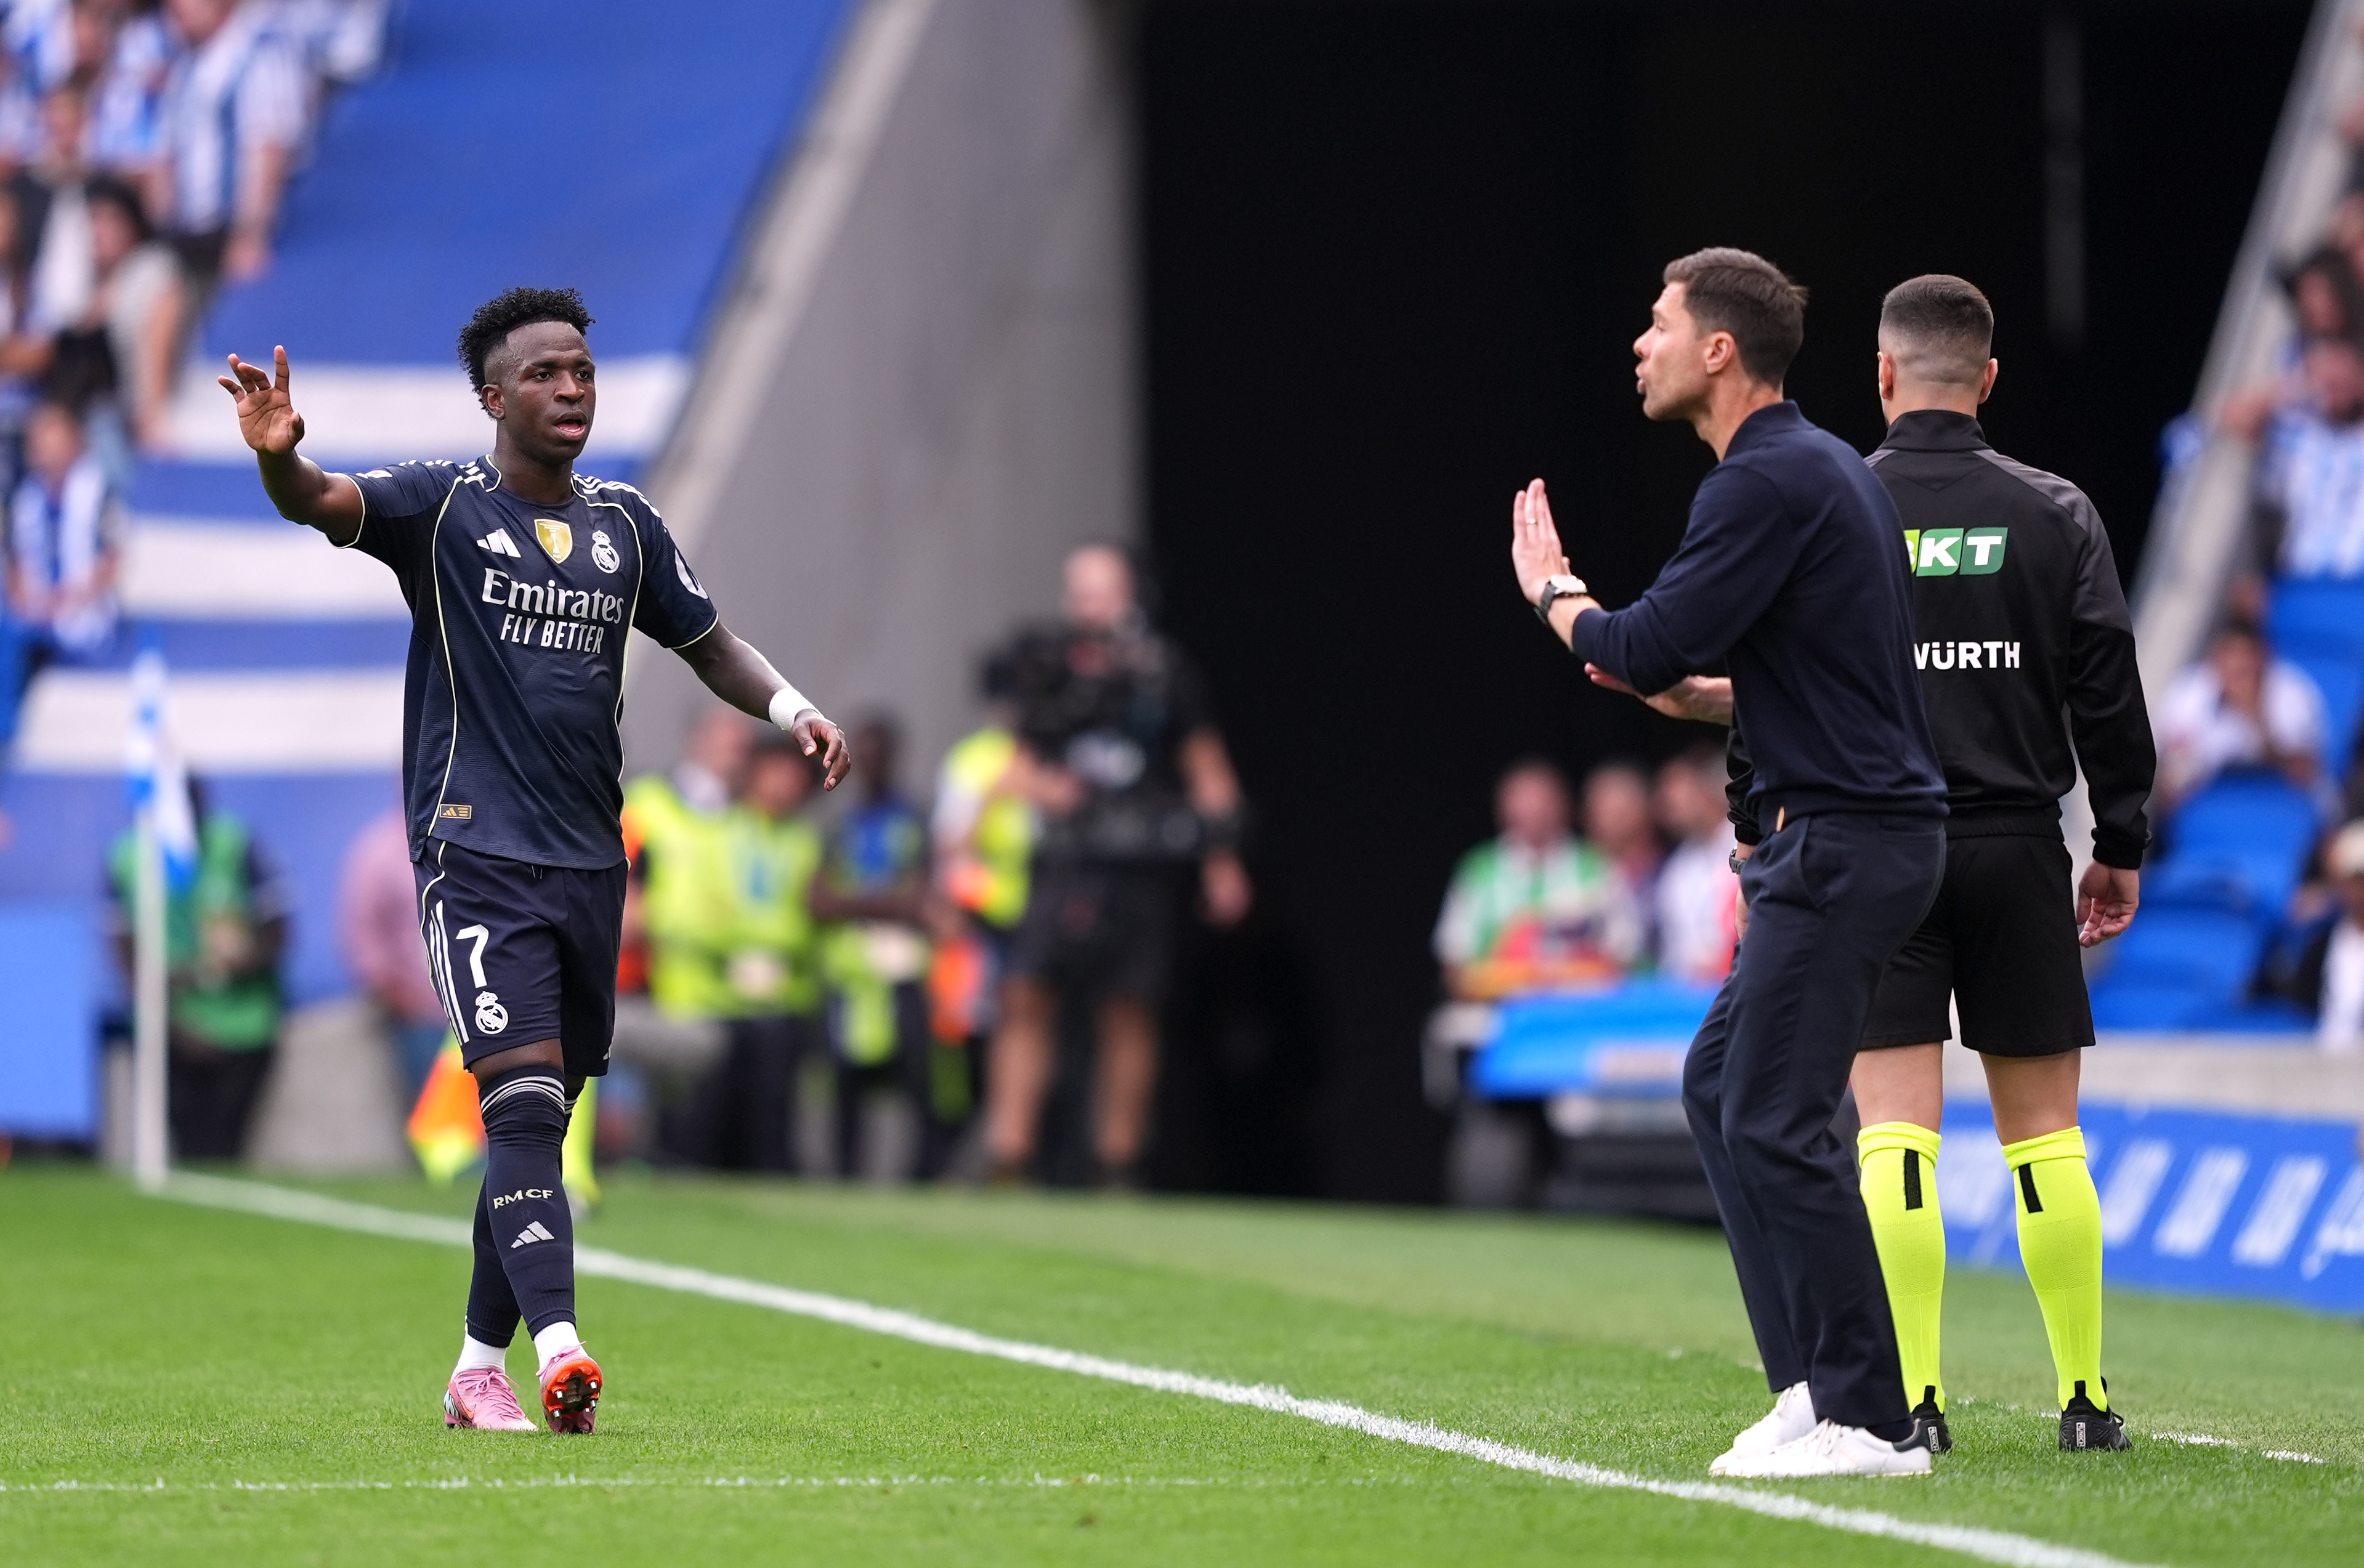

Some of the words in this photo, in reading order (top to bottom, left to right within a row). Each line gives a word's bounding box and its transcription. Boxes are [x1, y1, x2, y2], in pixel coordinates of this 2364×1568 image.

[1906, 535, 2002, 567] KT
[482, 567, 624, 624] Emirates
[500, 613, 538, 645] FLY
[540, 620, 604, 654] BETTER
[455, 924, 489, 988] 7
[493, 1189, 553, 1209] RMCF
